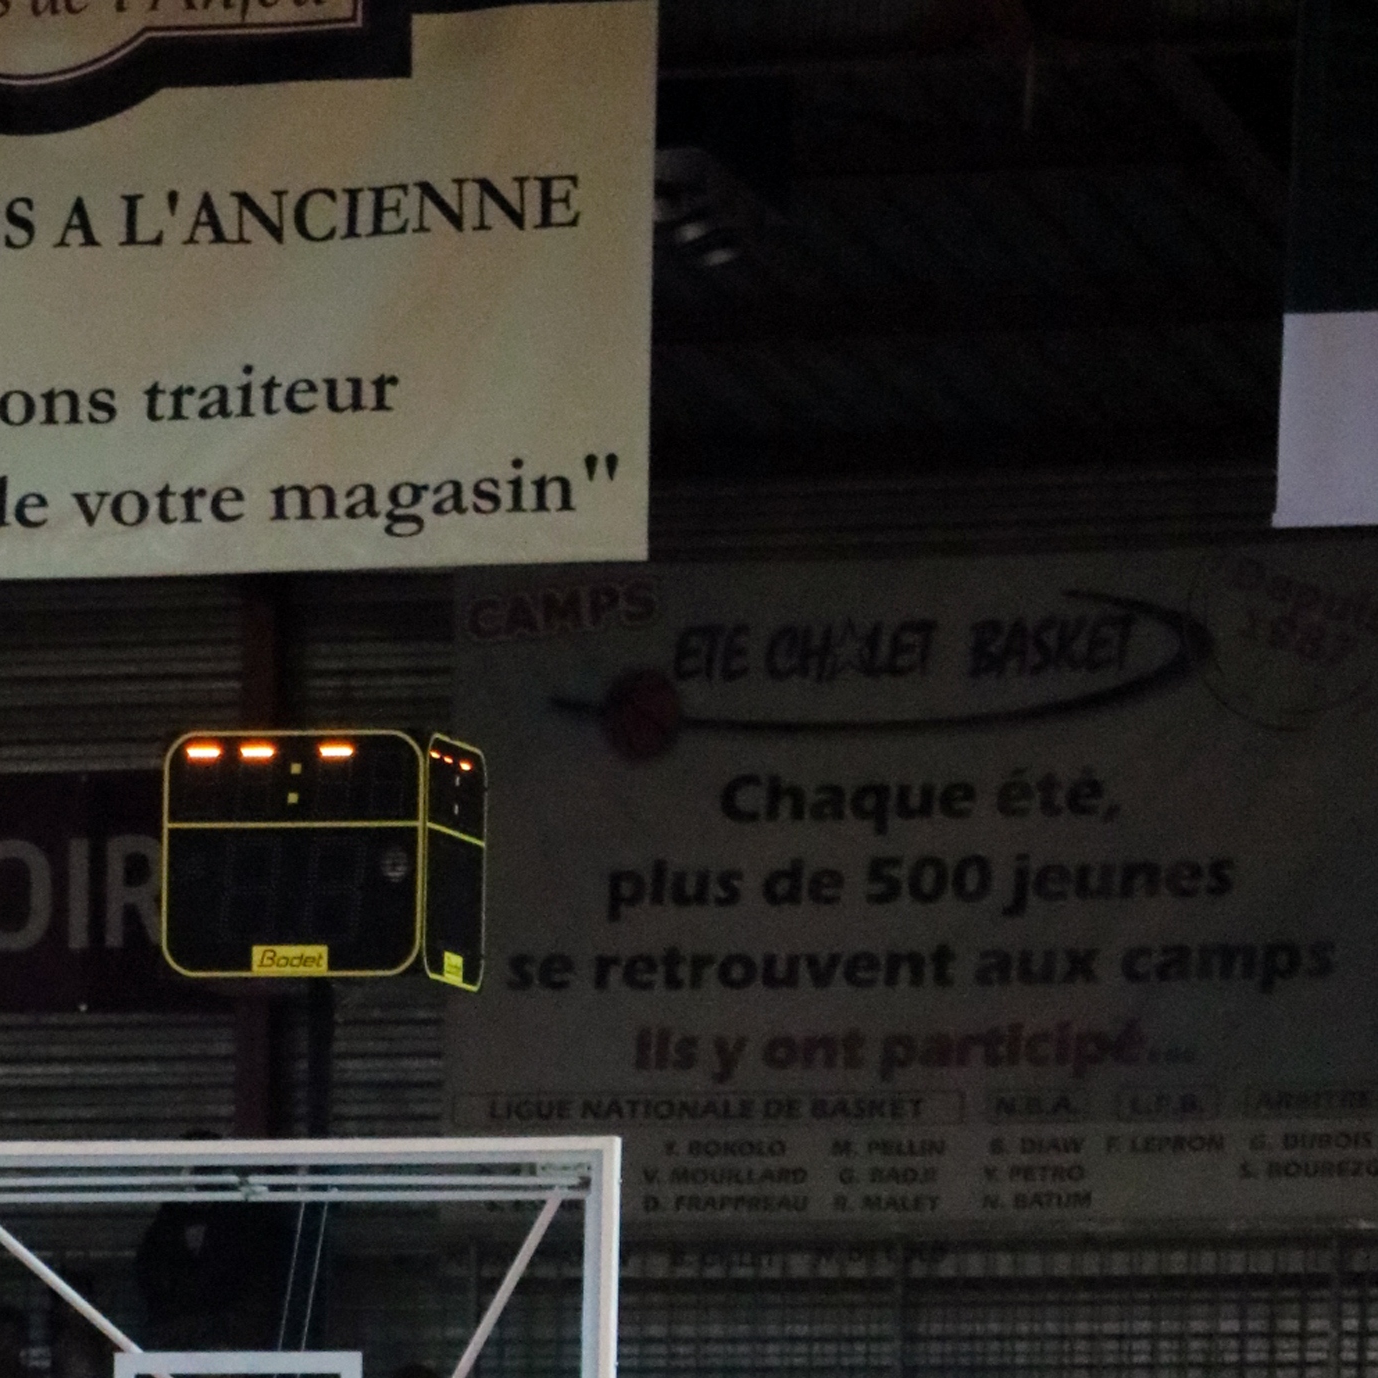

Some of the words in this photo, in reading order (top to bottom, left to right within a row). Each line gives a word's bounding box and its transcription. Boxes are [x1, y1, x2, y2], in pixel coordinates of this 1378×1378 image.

[53, 199, 102, 248] A
[119, 175, 581, 249] L'ANCIENNE
[143, 361, 400, 423] traiteur
[73, 471, 246, 525] votre
[269, 451, 620, 538] magasin"
[467, 579, 662, 640] CAMPS
[970, 614, 1136, 674] BASKET
[722, 772, 978, 835] Chaque
[607, 858, 744, 923] plus
[762, 857, 845, 908] de
[865, 854, 992, 906] 500
[1006, 854, 1236, 917] jeunes
[257, 950, 324, 968] Bodet
[508, 943, 574, 990] se
[593, 943, 954, 993] retrouvent
[975, 942, 1098, 985] aux
[1120, 934, 1338, 995] camps
[711, 1036, 749, 1083] y
[762, 1027, 867, 1070] ont
[489, 1099, 572, 1121] LIGUE
[580, 1098, 756, 1121] NATIONALE
[763, 1098, 802, 1120] DE
[810, 1097, 924, 1120] BASKET
